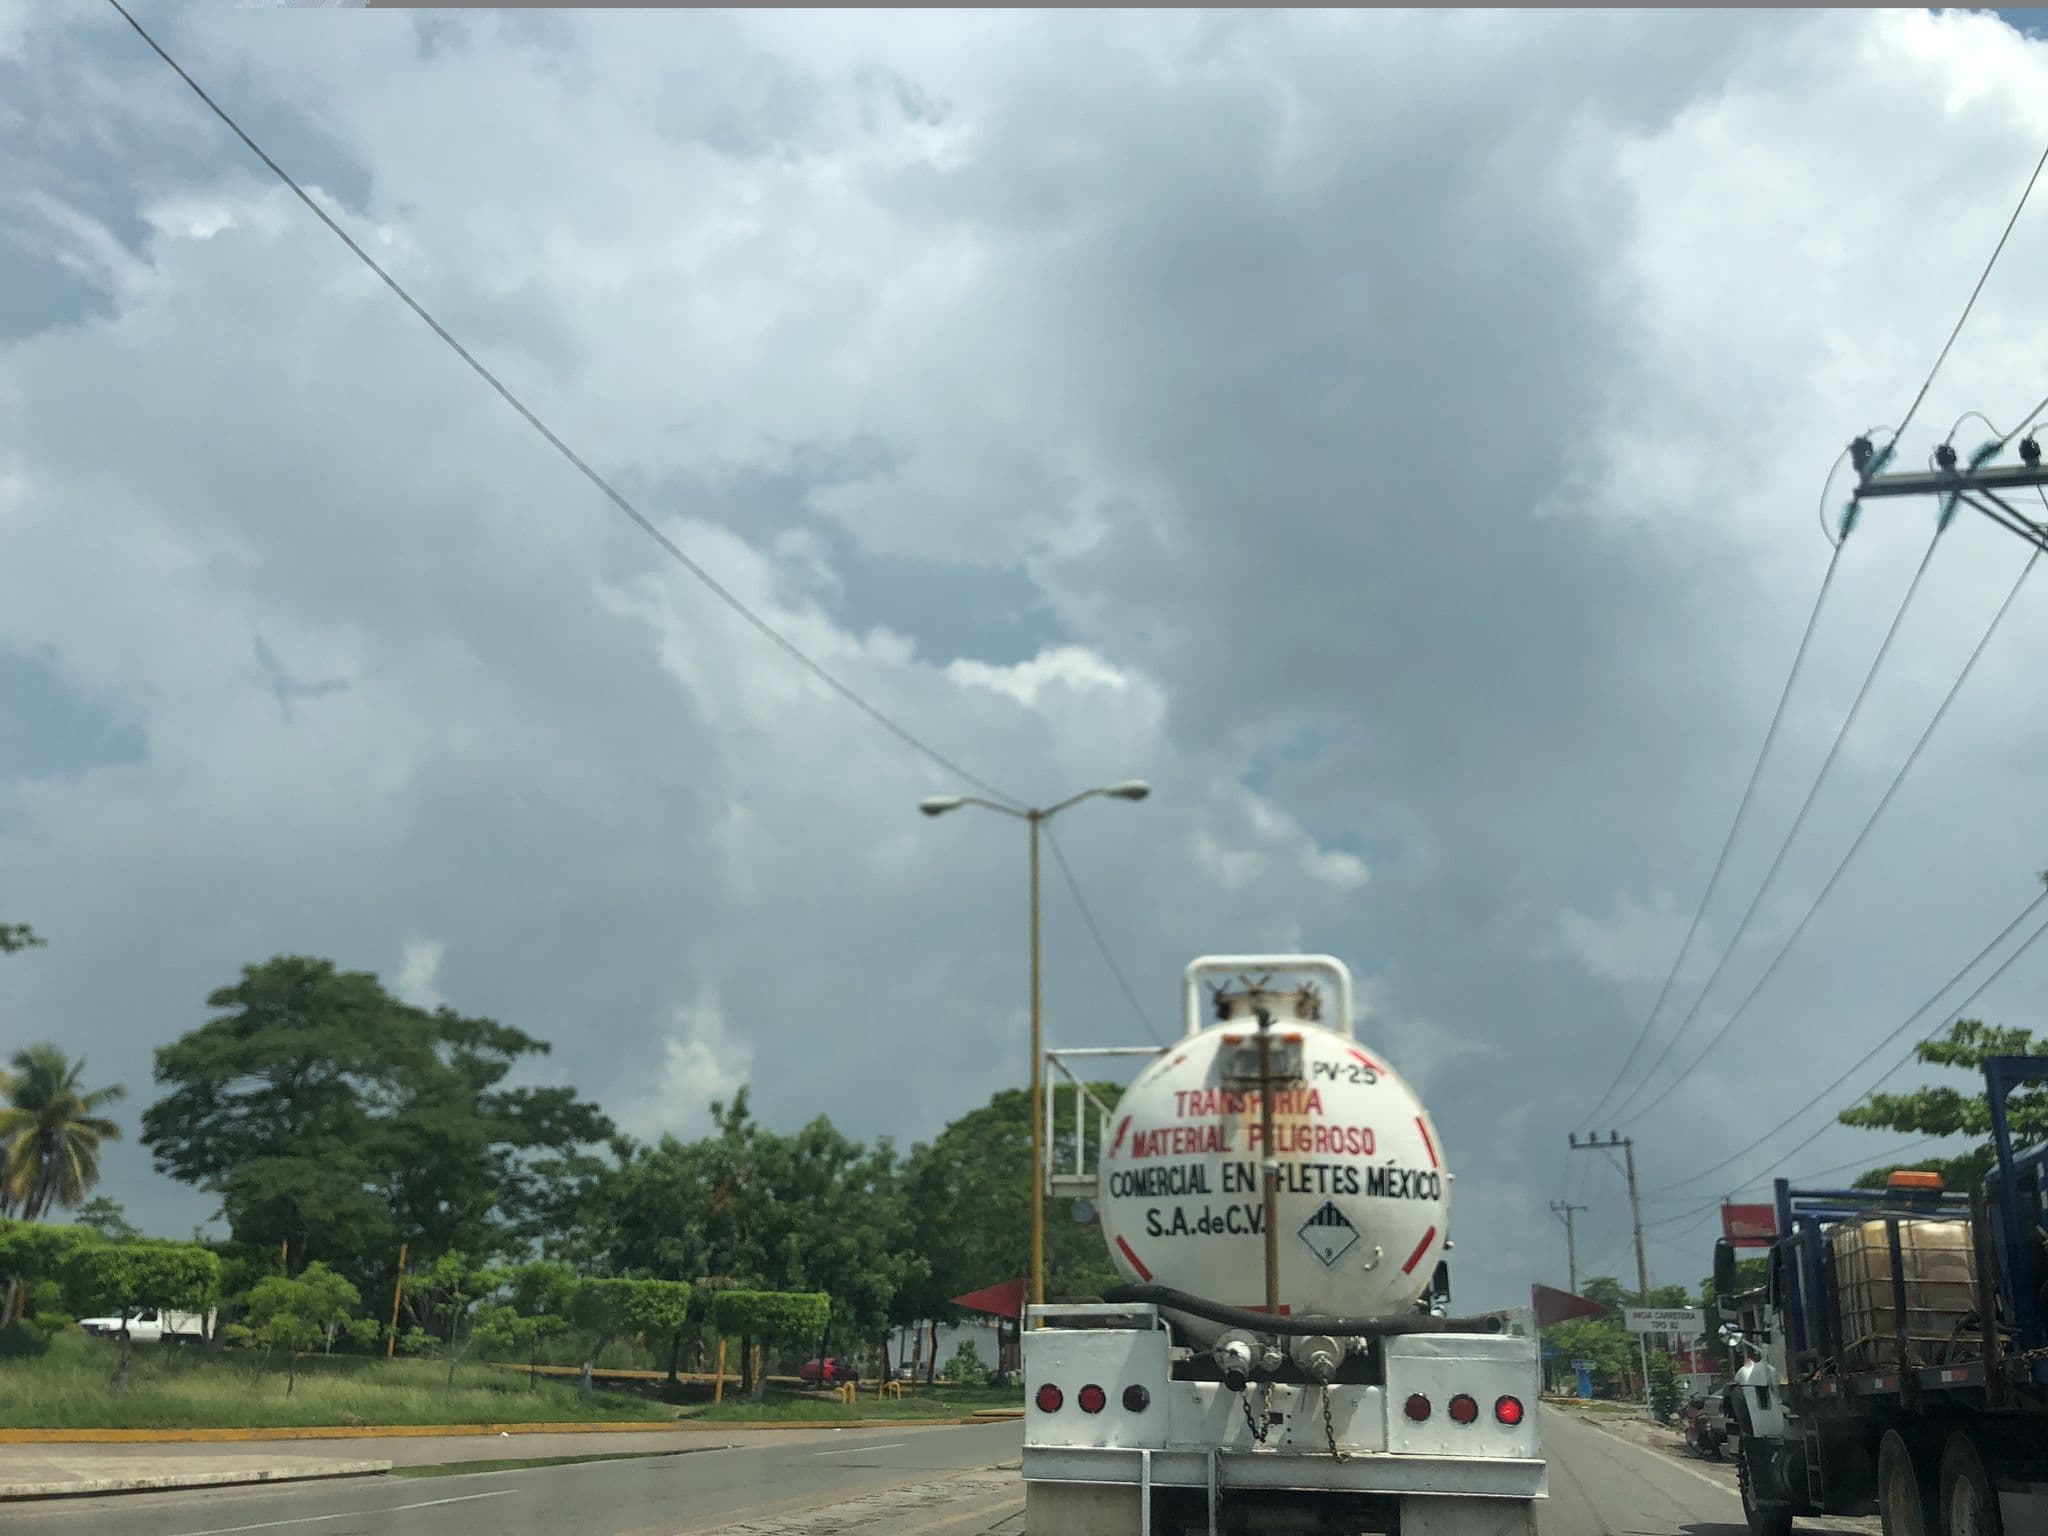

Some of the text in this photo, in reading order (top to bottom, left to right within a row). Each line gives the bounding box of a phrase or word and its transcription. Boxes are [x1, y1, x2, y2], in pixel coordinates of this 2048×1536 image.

[1313, 1061, 1377, 1085] PV-25
[1174, 1087, 1323, 1117] TRANSPRTA
[1131, 1123, 1376, 1158] MATERIAL PLIGROSO
[1110, 1159, 1441, 1201] COMERCIAL EN FLETES MÉXICO
